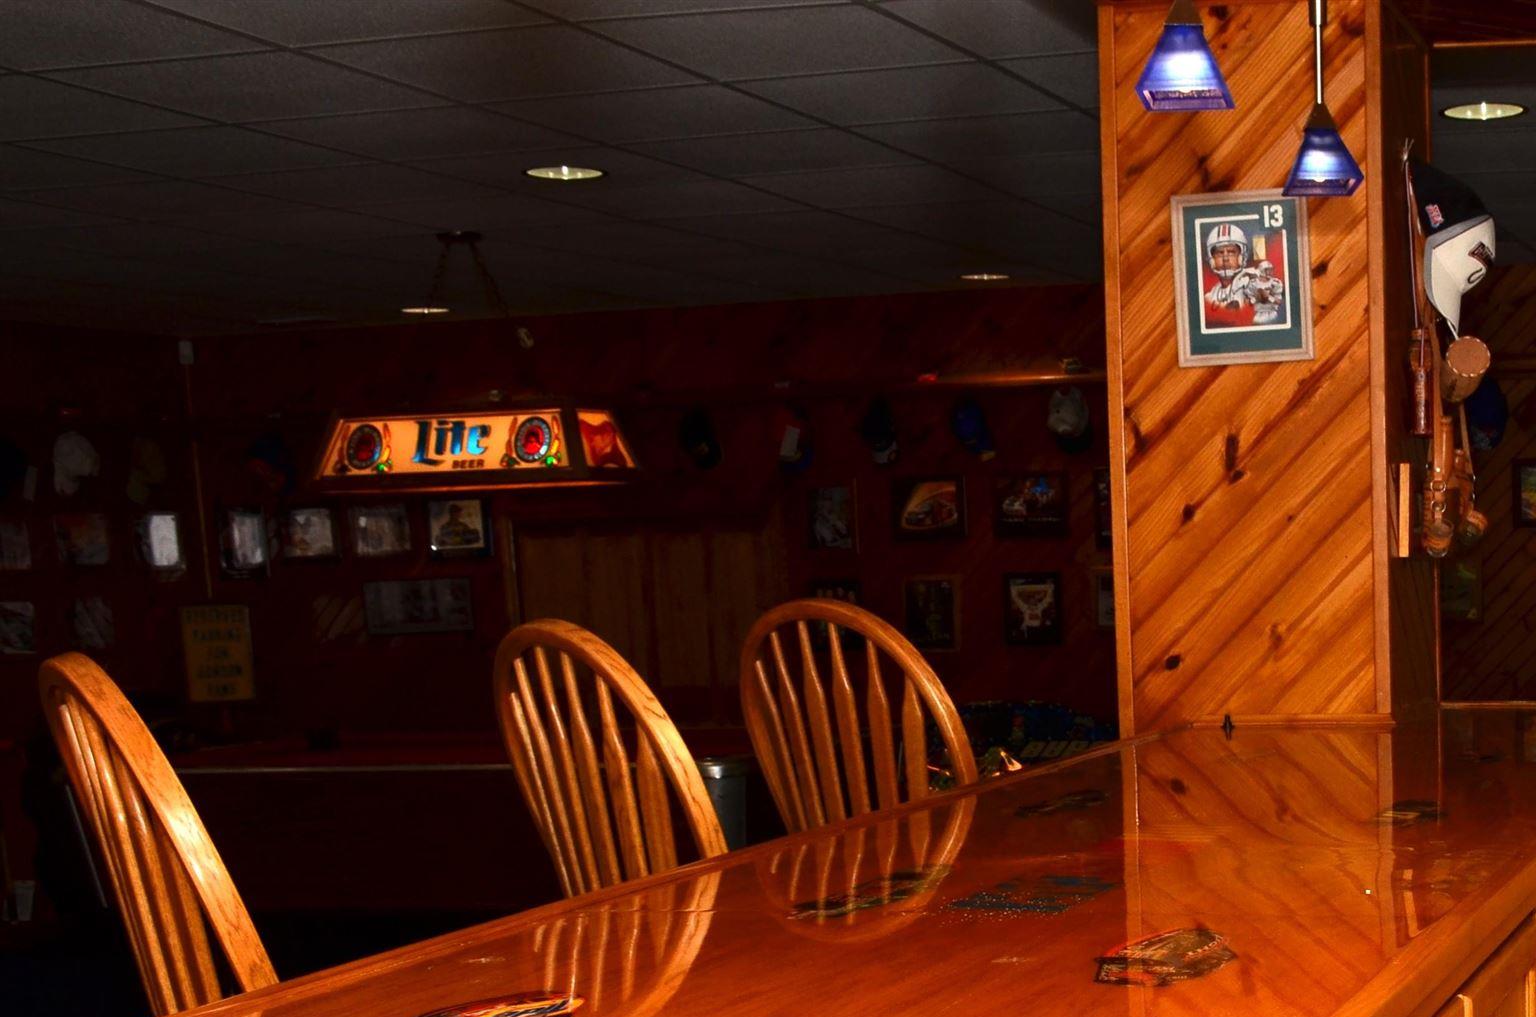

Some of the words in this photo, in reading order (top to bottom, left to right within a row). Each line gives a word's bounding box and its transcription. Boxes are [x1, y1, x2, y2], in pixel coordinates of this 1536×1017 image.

[1263, 204, 1283, 228] 13
[412, 420, 491, 466] Lite
[452, 458, 484, 469] BEER
